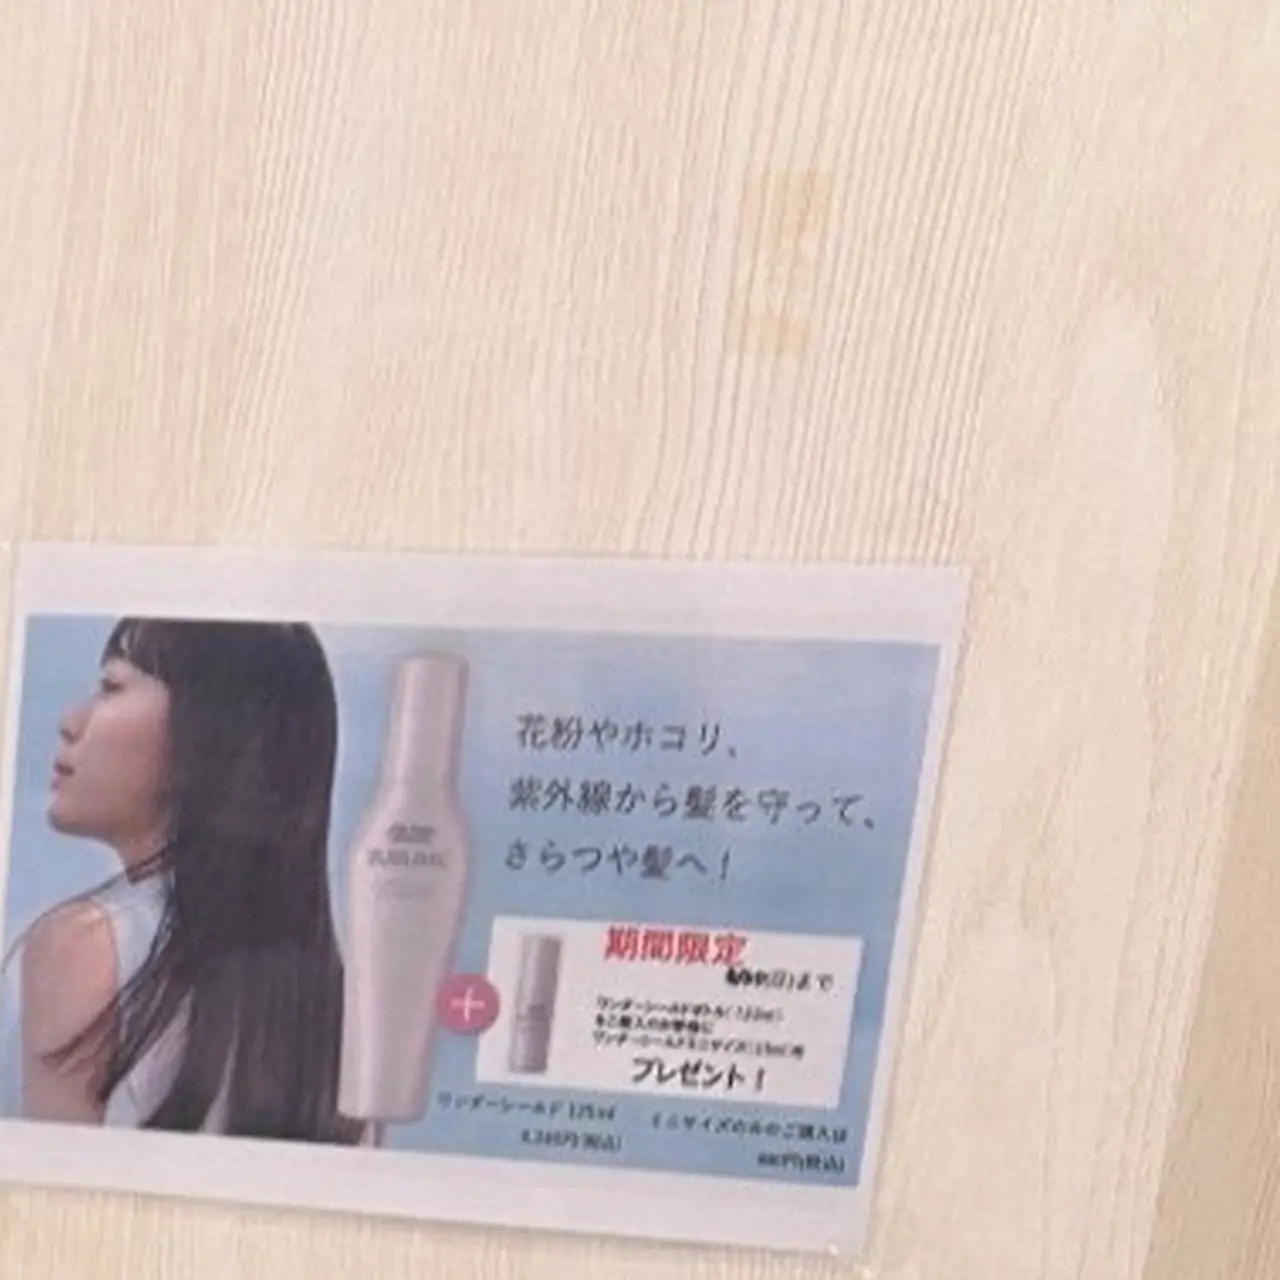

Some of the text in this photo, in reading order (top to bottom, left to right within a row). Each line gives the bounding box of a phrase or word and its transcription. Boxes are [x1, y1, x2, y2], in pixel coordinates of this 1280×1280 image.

[517, 712, 737, 758] 花粉やホコリ、
[508, 775, 875, 830] 紫外線から髪を守って、
[603, 925, 747, 966] 期間限定
